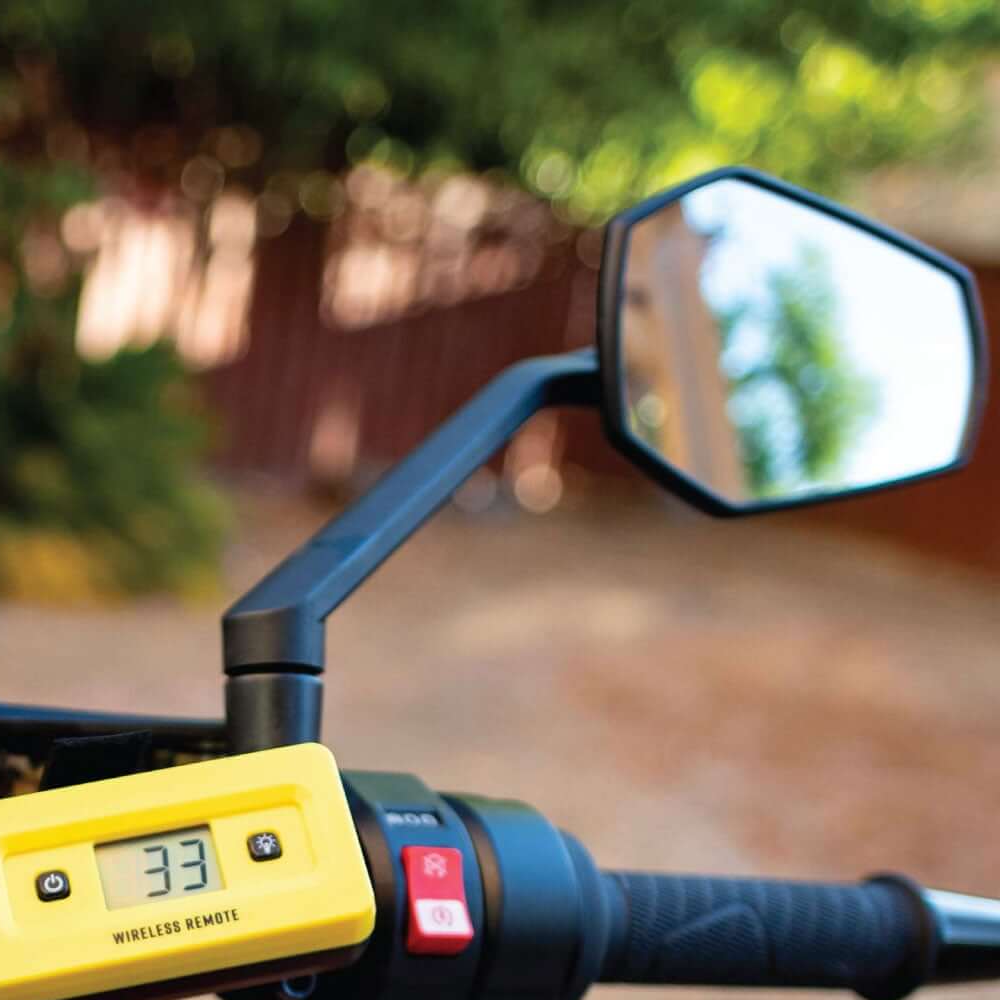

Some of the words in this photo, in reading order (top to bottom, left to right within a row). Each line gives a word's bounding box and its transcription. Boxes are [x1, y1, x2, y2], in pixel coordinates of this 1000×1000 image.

[143, 839, 208, 897] 33
[112, 920, 181, 944] WIRELESS
[185, 908, 240, 931] REMOTE
